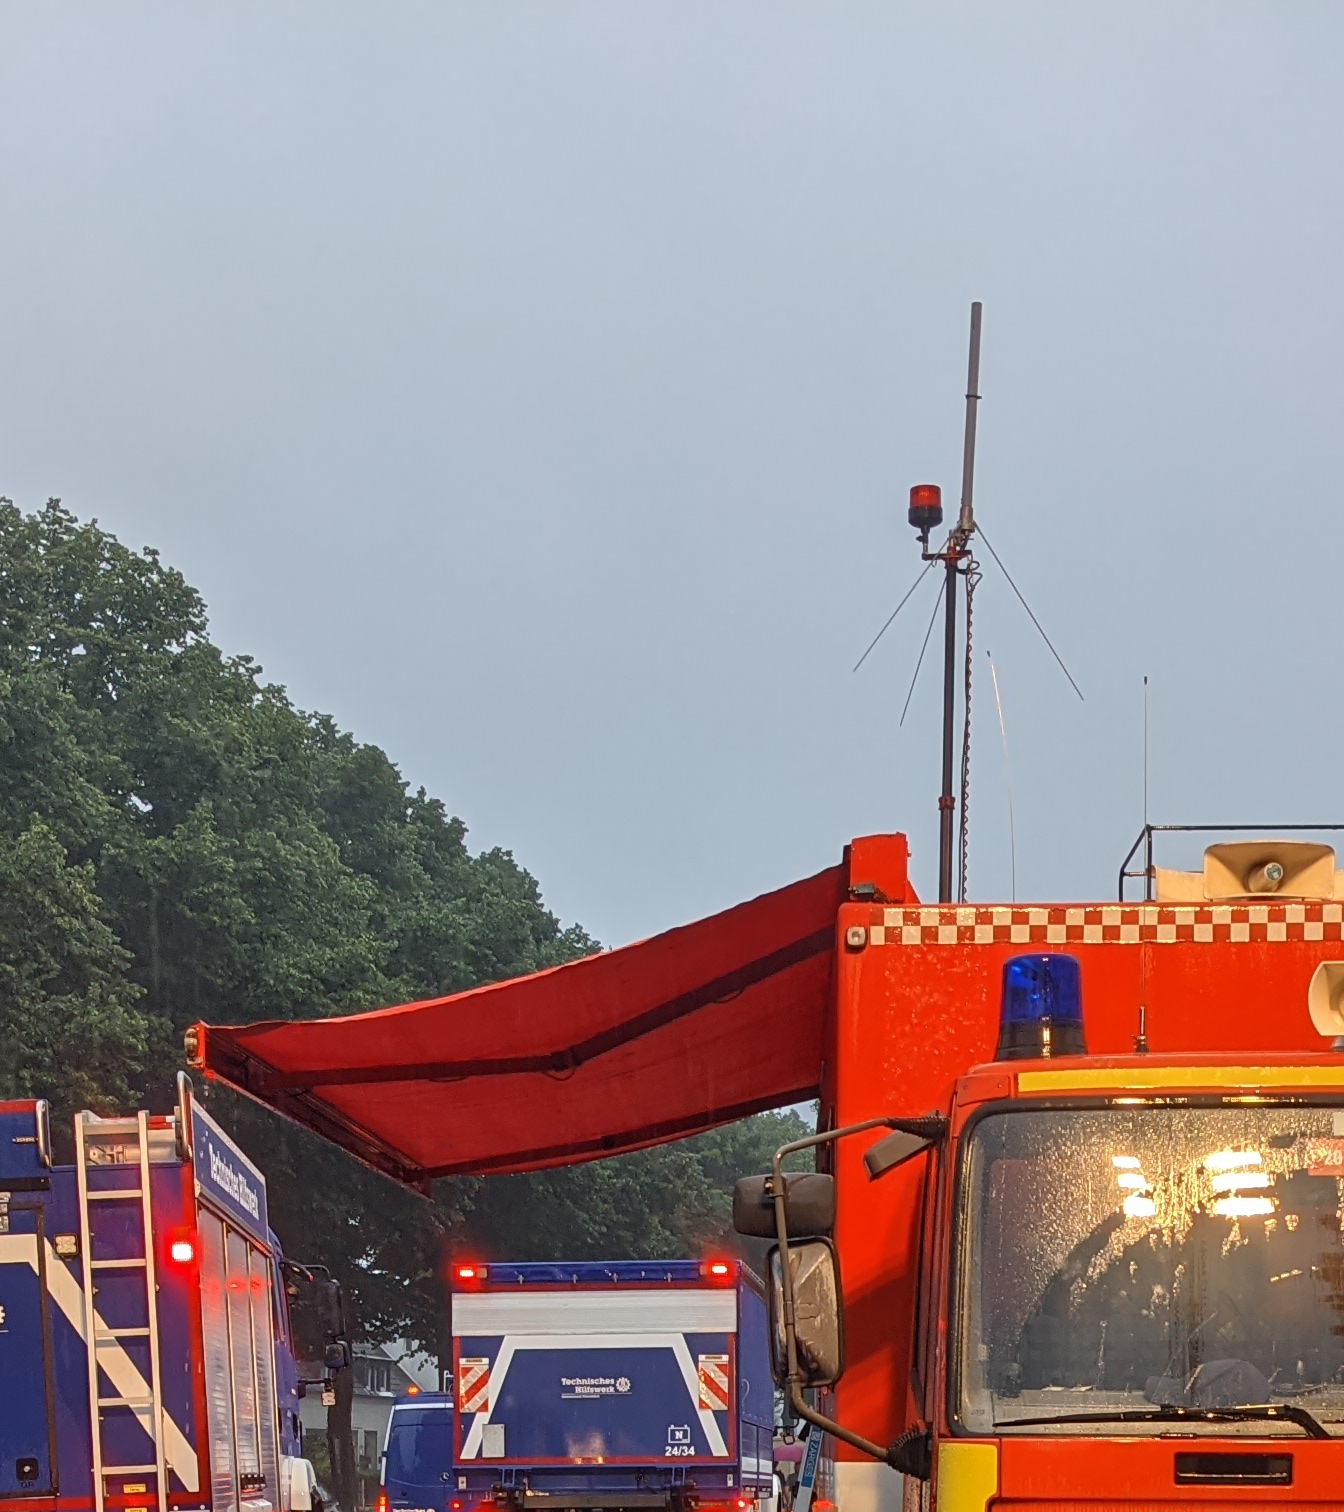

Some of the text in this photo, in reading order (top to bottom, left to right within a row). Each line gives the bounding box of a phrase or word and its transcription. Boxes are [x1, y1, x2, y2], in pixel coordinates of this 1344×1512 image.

[561, 1377, 615, 1386] Technisches
[674, 1430, 684, 1440] N
[664, 1445, 696, 1457] 24/34
